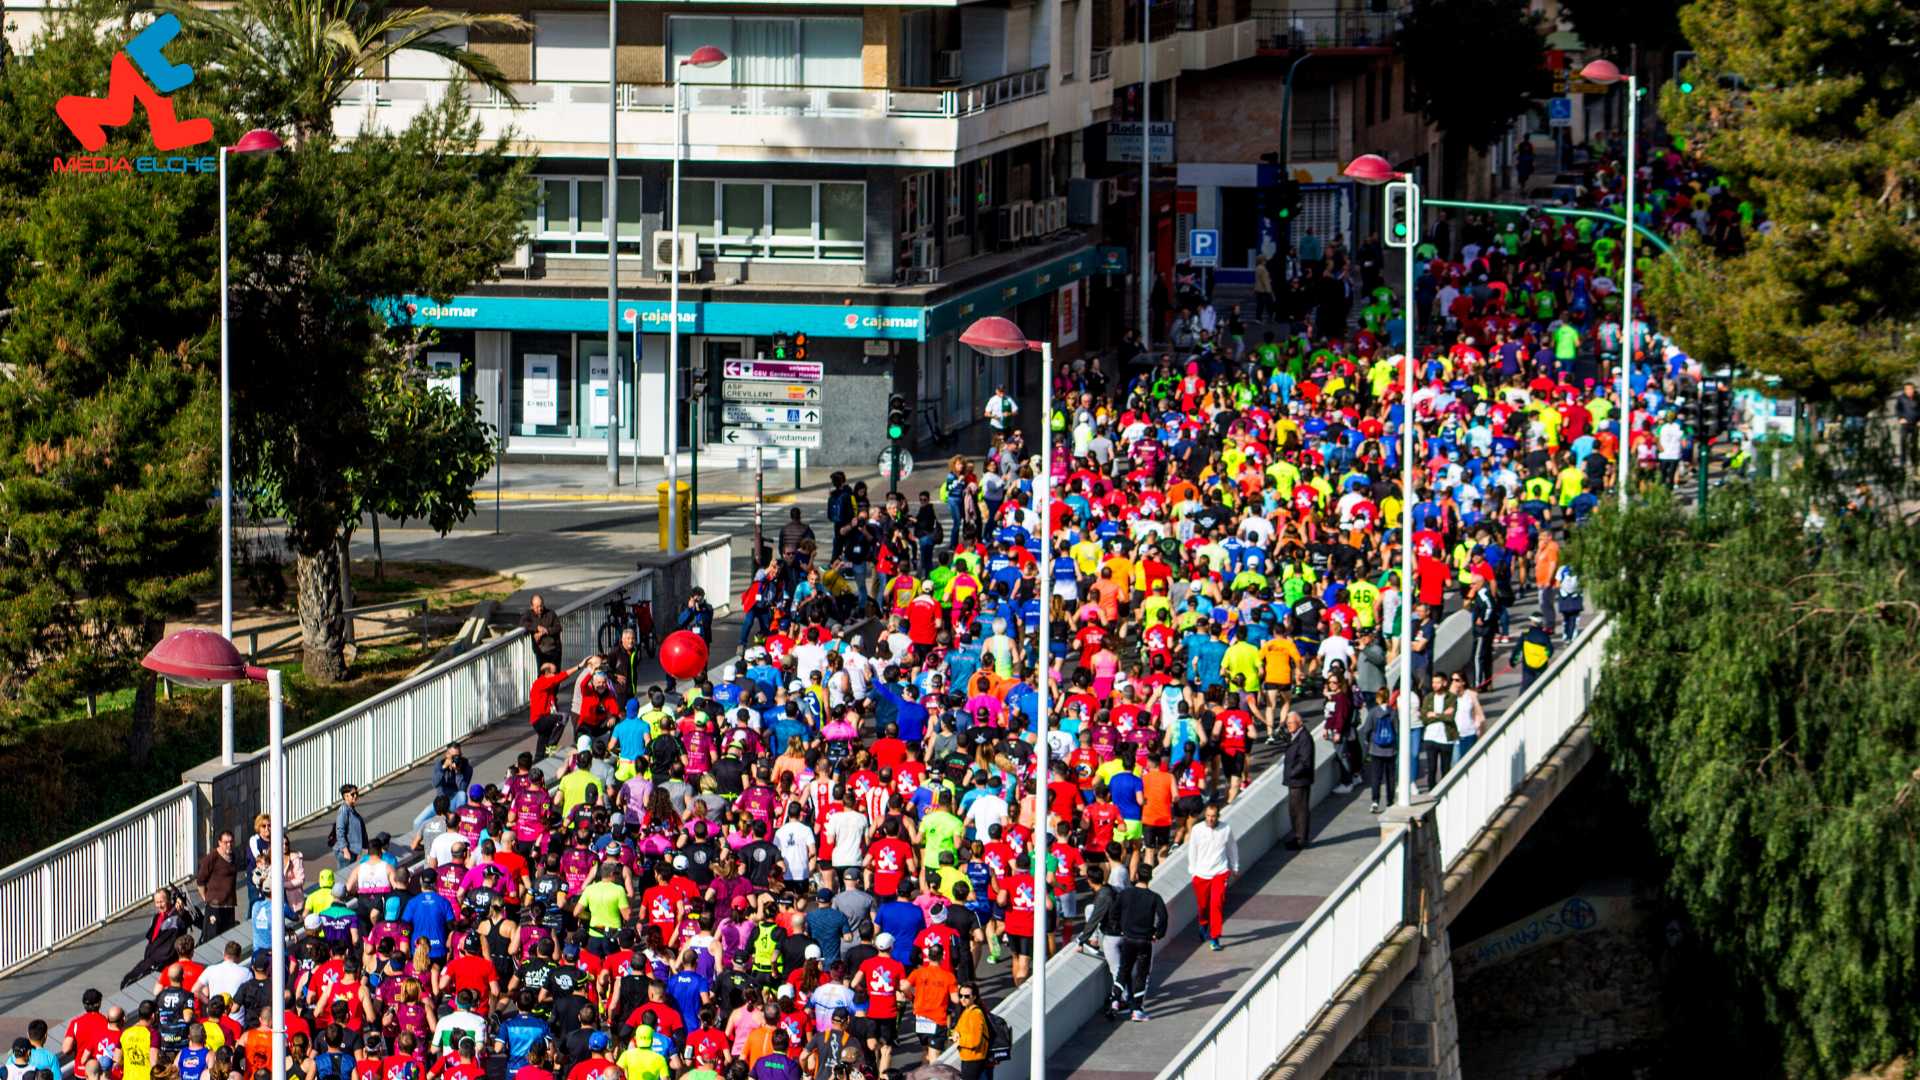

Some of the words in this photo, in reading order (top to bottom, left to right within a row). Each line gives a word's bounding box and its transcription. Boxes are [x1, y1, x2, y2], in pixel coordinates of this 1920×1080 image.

[1110, 123, 1170, 133] Rodetal
[1195, 233, 1212, 254] P
[421, 303, 478, 320] cajamar
[862, 315, 920, 331] cajamar
[726, 390, 773, 398] CREVILLENT
[1353, 589, 1372, 603] 46
